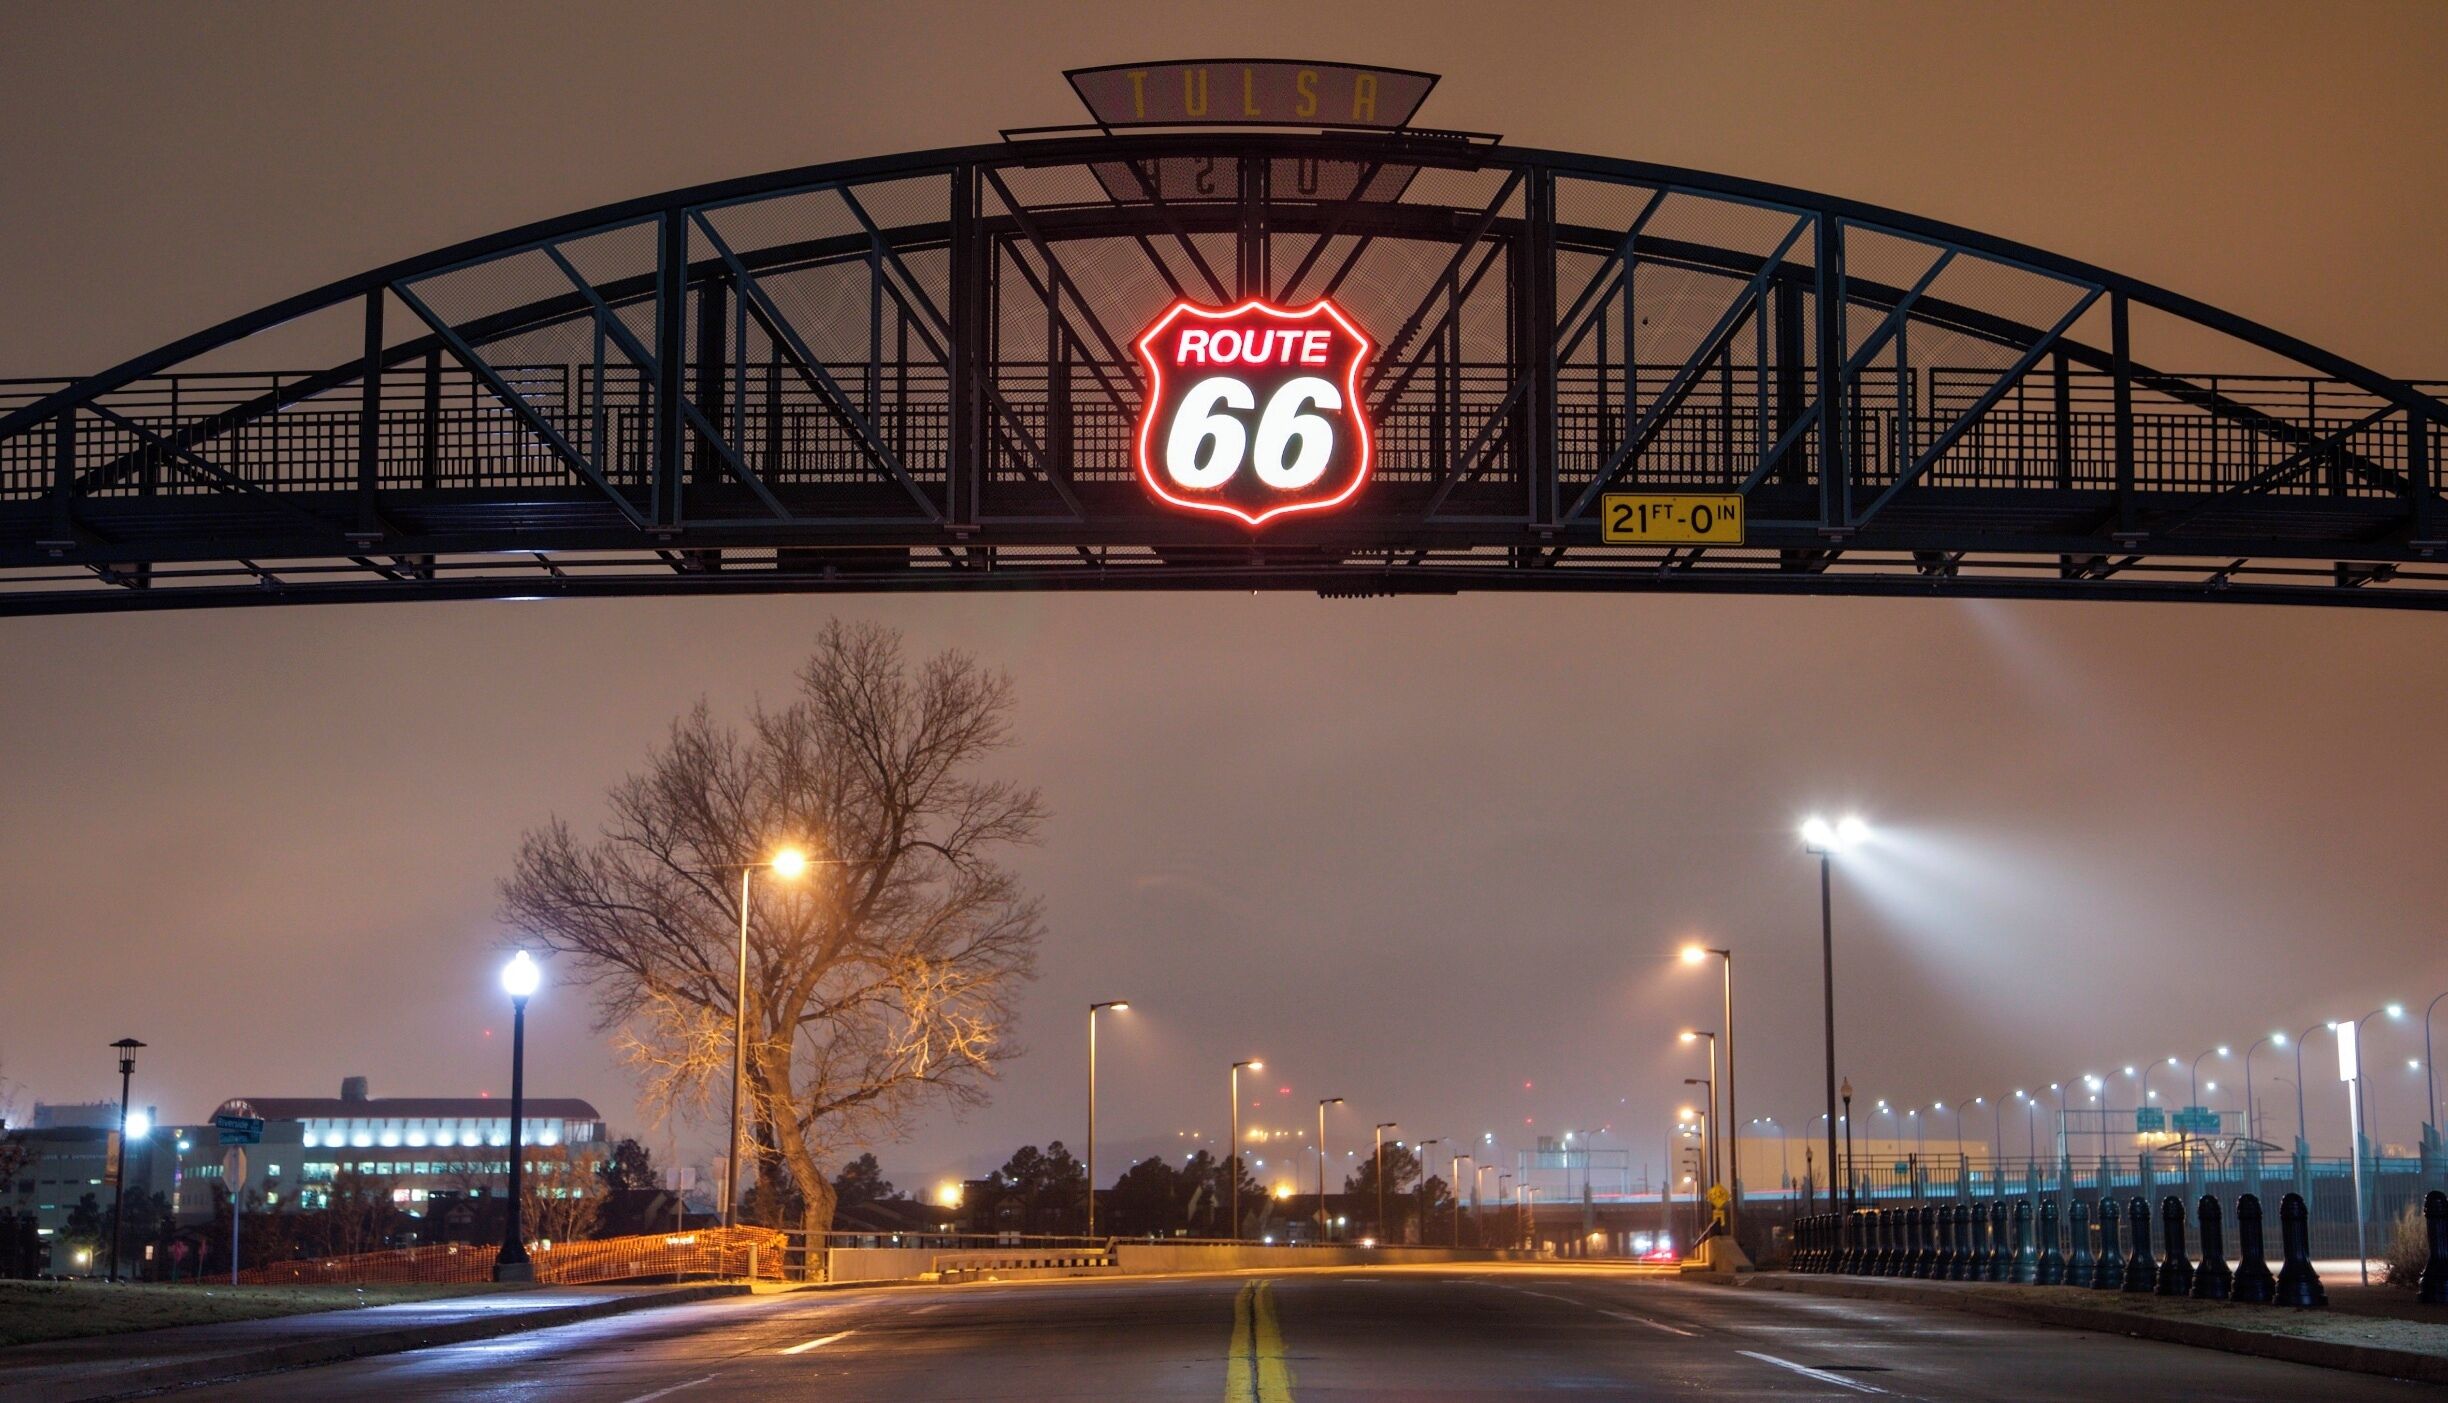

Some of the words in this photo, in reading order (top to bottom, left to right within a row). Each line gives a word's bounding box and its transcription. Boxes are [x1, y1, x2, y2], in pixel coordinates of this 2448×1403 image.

[1127, 68, 1378, 122] TULSA
[1177, 329, 1332, 364] ROUTE
[1166, 376, 1342, 489] 66
